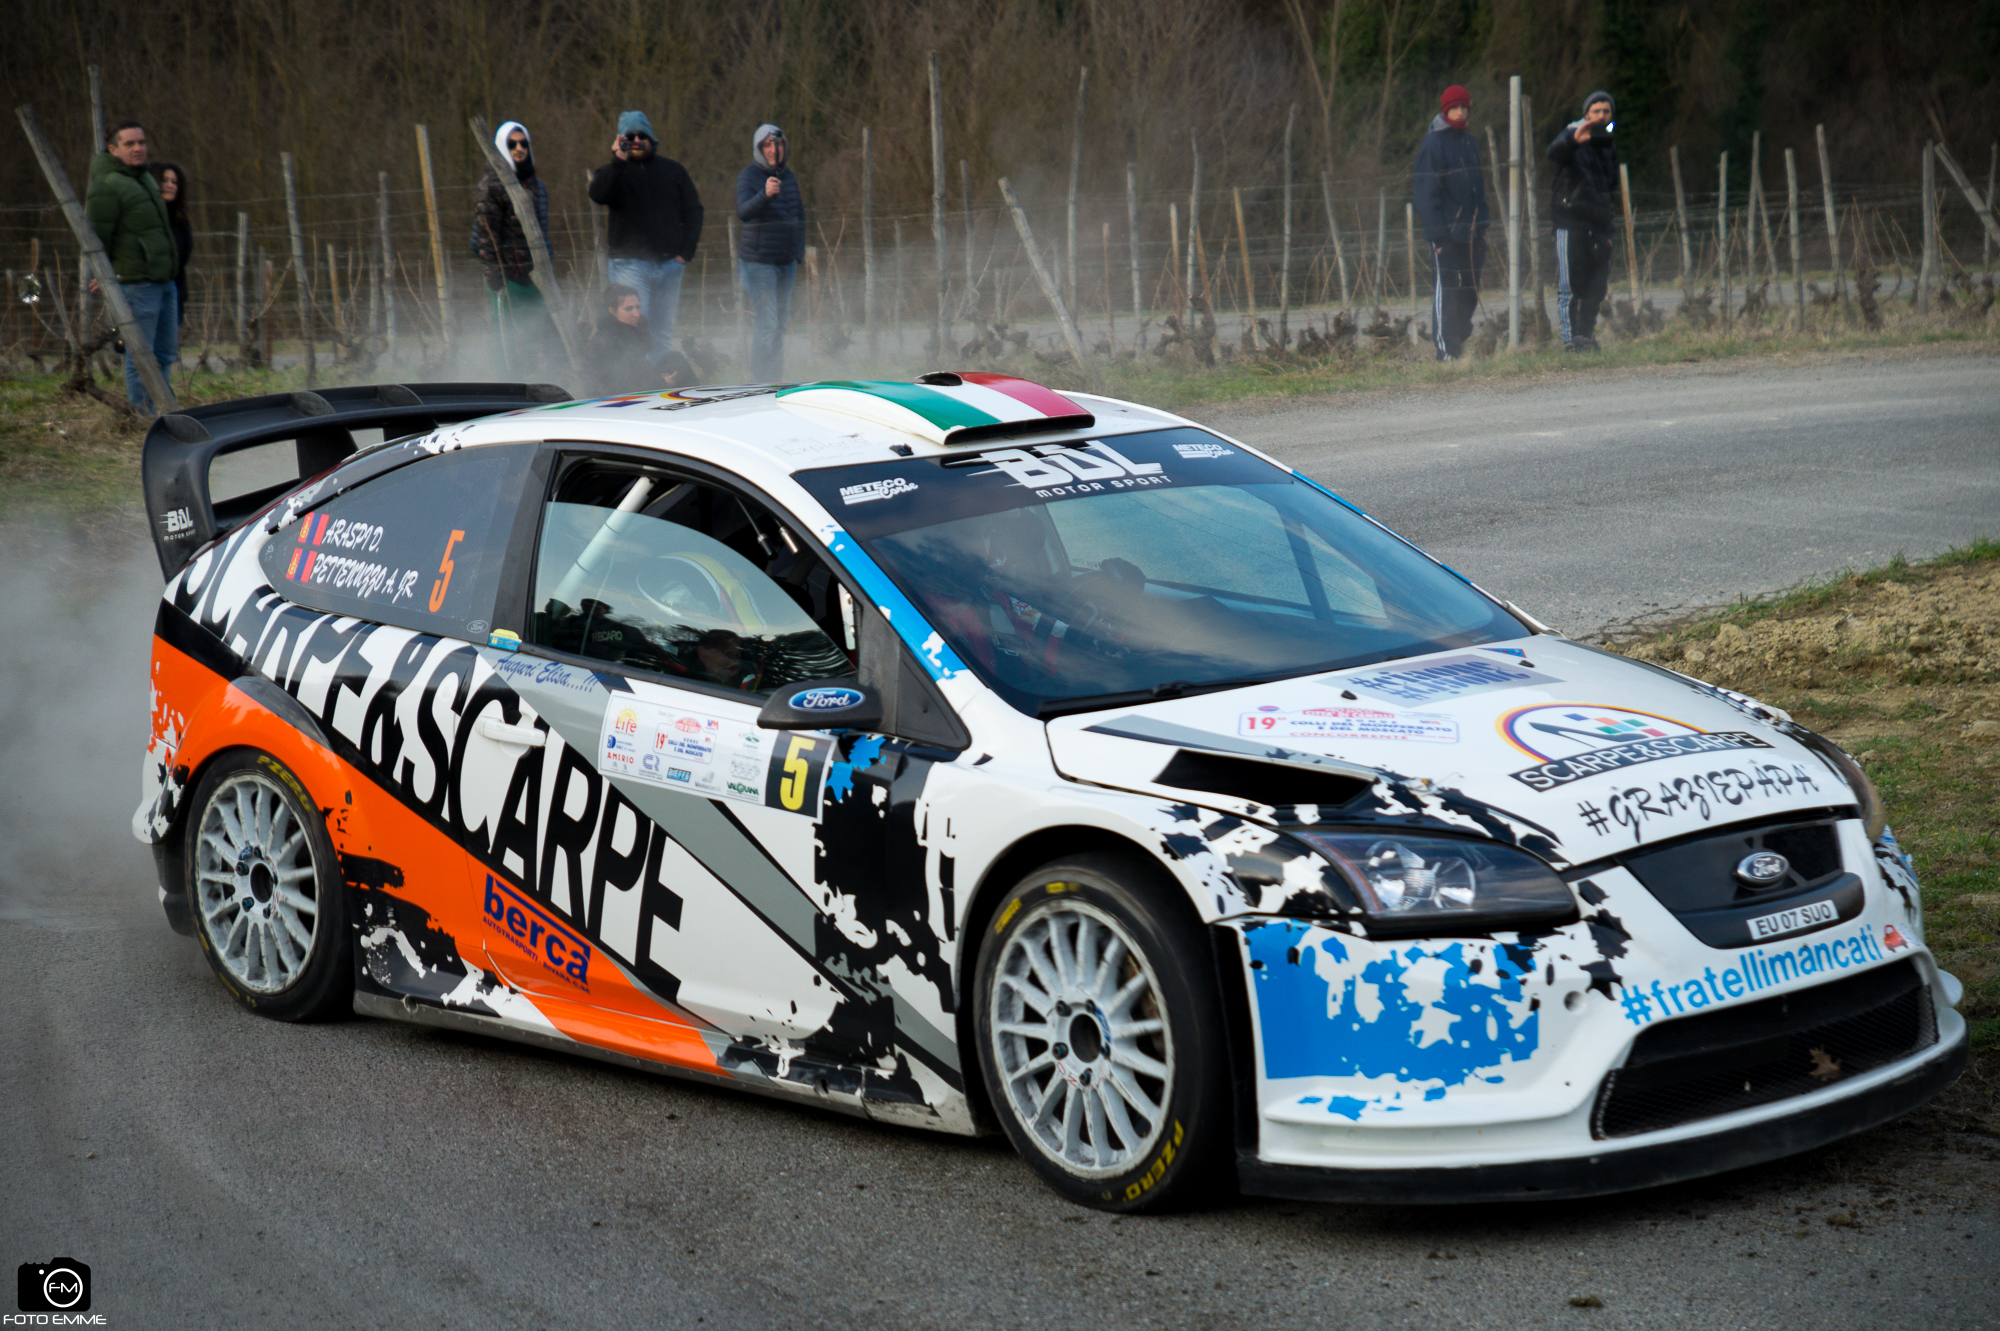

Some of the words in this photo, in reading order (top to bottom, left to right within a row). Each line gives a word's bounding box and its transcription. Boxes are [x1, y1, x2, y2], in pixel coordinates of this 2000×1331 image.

[1172, 443, 1222, 452] METECO
[965, 440, 1164, 489] BDL
[839, 477, 906, 496] METECO
[880, 482, 919, 499] Corse
[1035, 482, 1106, 498] MOTOR
[1110, 474, 1172, 488] SPORT
[163, 506, 194, 533] BDL
[429, 529, 466, 613] 5
[802, 690, 850, 708] Ford
[615, 716, 637, 734] Life
[1290, 732, 1407, 740] CONCORRENTE
[1358, 727, 1425, 735] MOSCATO
[1360, 722, 1452, 732] MONFERRATO
[607, 751, 635, 764] AMERIO
[1519, 732, 1766, 789] SCARPE&SCARPE
[779, 735, 817, 811] 5
[1752, 856, 1782, 877] Ford
[484, 872, 590, 986] berca
[1755, 918, 1778, 936] EU
[1782, 911, 1797, 930] 07
[1802, 904, 1832, 926] SUO
[482, 915, 538, 962] AUTOTRASPORTI
[542, 960, 571, 984] RIVARA
[1620, 923, 1884, 1026] #fratellimancati
